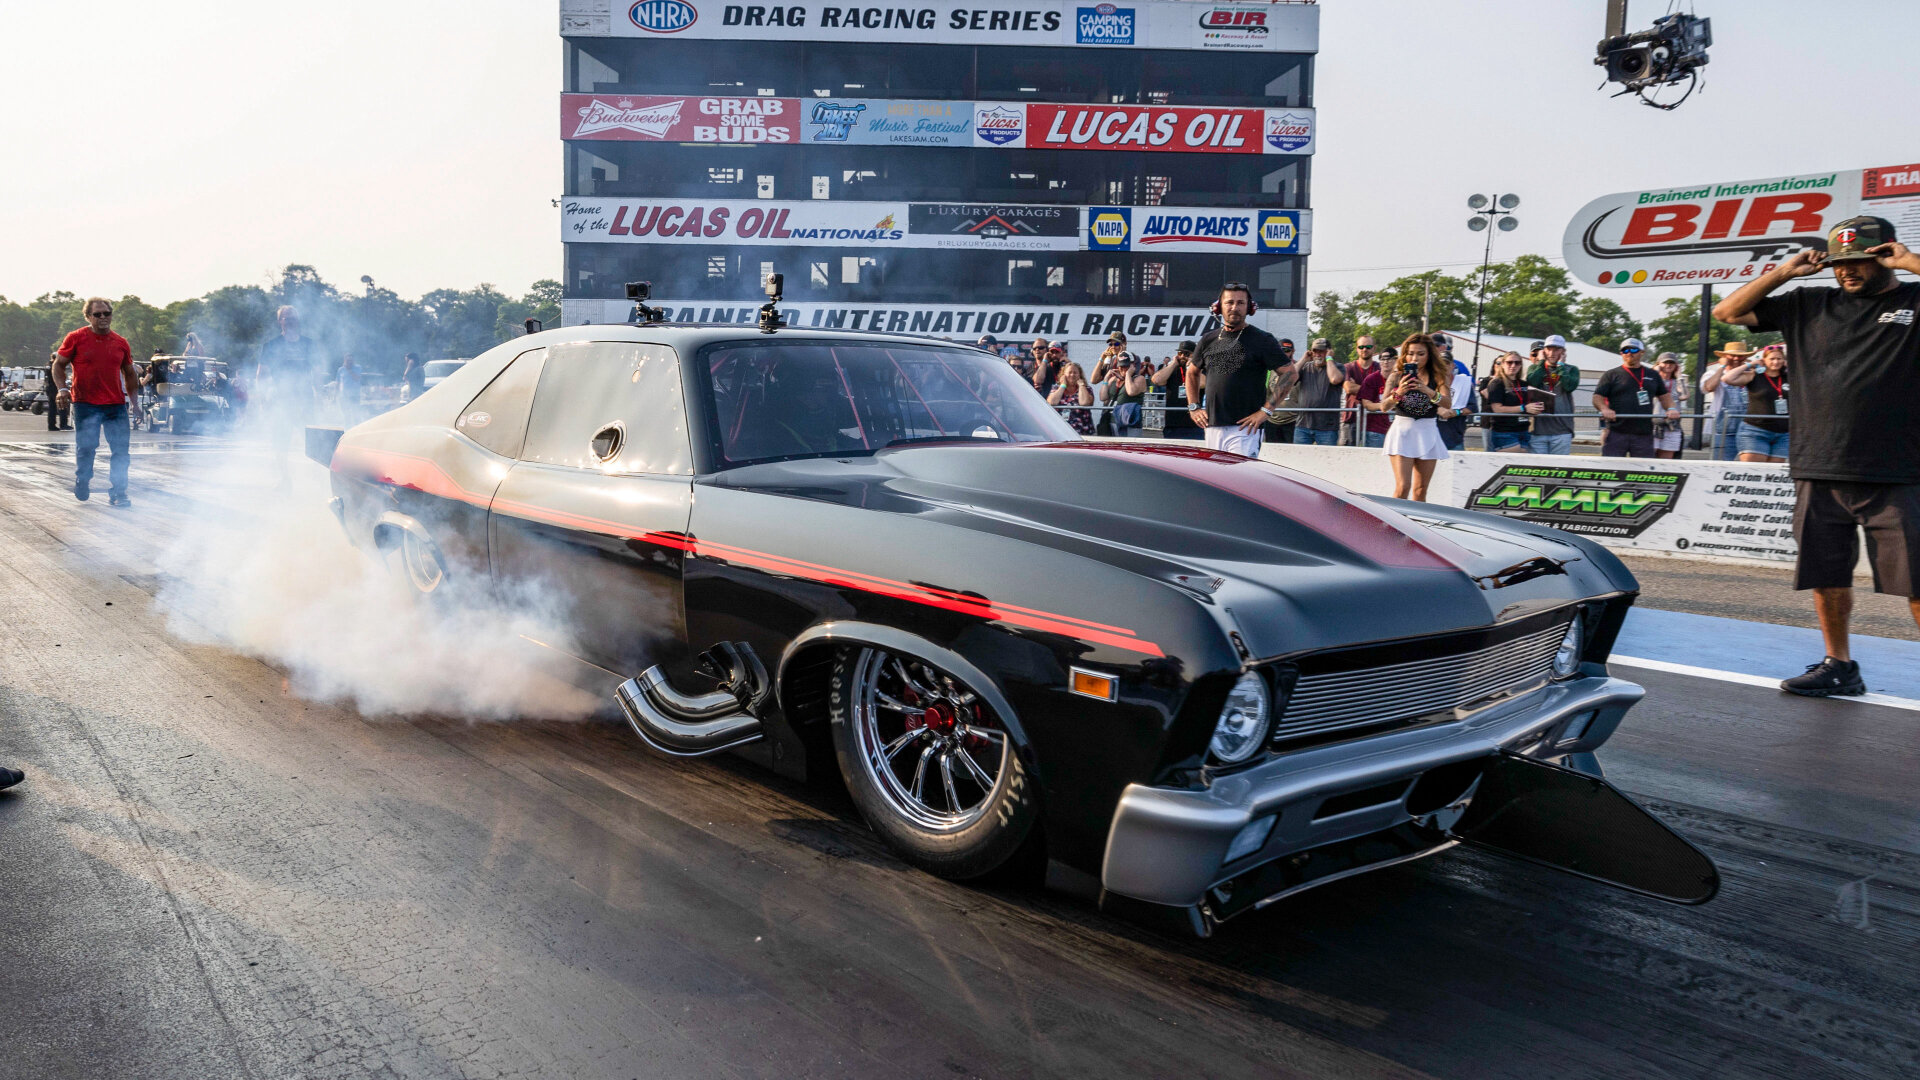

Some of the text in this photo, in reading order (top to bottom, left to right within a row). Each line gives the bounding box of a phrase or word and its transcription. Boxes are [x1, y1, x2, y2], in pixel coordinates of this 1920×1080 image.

[637, 2, 691, 28] NHRA
[722, 5, 1062, 32] DRAG RACING SERIES
[1080, 14, 1132, 26] CAMPING
[1209, 11, 1267, 25] BIR
[1080, 25, 1132, 38] WORLD
[700, 98, 784, 115] GRAB
[888, 104, 952, 117] MORE THAN A
[579, 107, 680, 125] Budweiser
[721, 115, 765, 127] SOME
[815, 106, 859, 124] LAKES
[869, 118, 970, 134] Music Festival
[982, 118, 1021, 129] LUCAS
[1045, 110, 1246, 148] LUCAS OIL
[1271, 125, 1309, 135] LUCAS
[693, 125, 790, 142] BUDS
[819, 124, 850, 139] JAM
[889, 135, 949, 143] LAKESJAM.COM
[1637, 173, 1837, 205] Brainerd International
[565, 202, 602, 216] Home
[929, 206, 1061, 218] LUXURY GARAGES
[573, 217, 609, 234] of the
[608, 205, 793, 239] LUCAS OIL
[1143, 215, 1250, 237] AUTO PARTS
[1619, 192, 1833, 246] BIR
[791, 228, 903, 241] NATIONALS
[1097, 221, 1123, 237] NAPA
[1265, 224, 1291, 240] NAPA
[937, 240, 1050, 249] BIRLUXURYGARAGES.COM
[1652, 267, 1736, 282] Raceway
[1739, 264, 1754, 277] &
[628, 306, 1223, 337] RAINED INTERNATIONAL RACEWA
[1506, 467, 1679, 484] MIDSOTA METAL WORKS
[1723, 471, 1794, 483] Custom Weld
[1713, 484, 1734, 494] CNC
[1735, 485, 1772, 497] Plasma
[1477, 485, 1670, 515] MMW
[1729, 498, 1796, 513] Sandblasting
[1720, 511, 1793, 525] Powder Coati
[1562, 523, 1630, 535] FABRICATION
[1701, 523, 1723, 533] New
[1725, 524, 1756, 536] Builds
[1758, 528, 1777, 537] and
